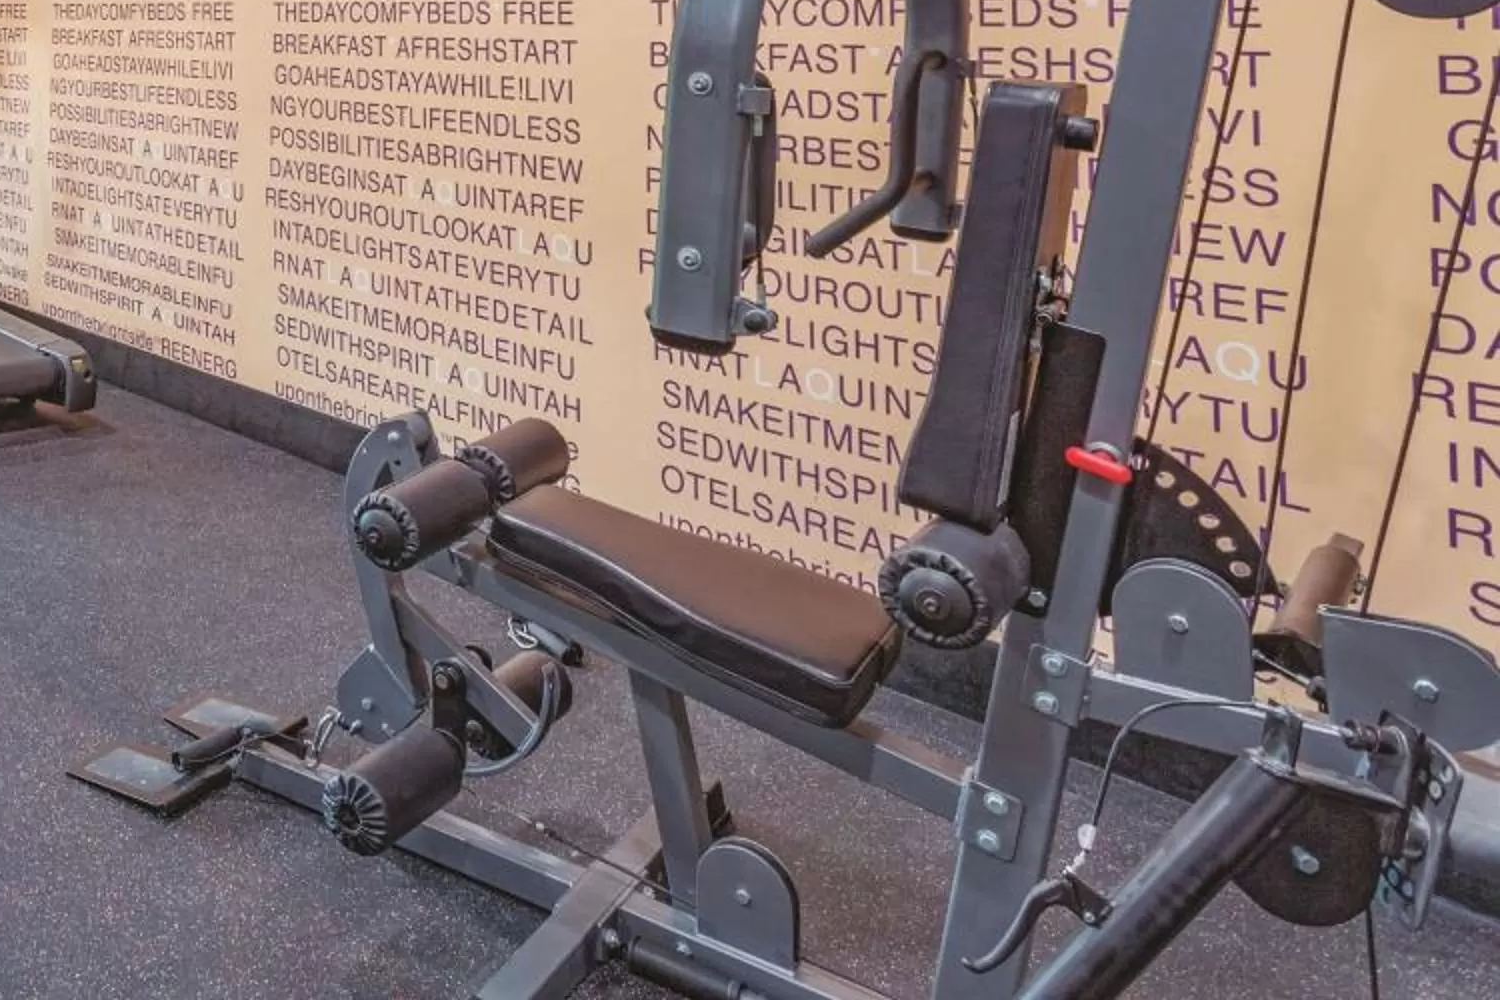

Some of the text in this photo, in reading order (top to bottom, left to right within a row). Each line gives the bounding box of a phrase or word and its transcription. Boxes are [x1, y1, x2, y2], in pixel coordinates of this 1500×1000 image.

[0, 4, 27, 20] FREE
[192, 2, 234, 21] FREE
[273, 1, 575, 25] THEDAYCOMFYBEDS FREE
[52, 28, 123, 47] BREAKFAST
[273, 34, 578, 65] BREAKFAST AFRESHSTART
[274, 63, 574, 104] GOAHEADSTAYAWHILE!LIVI
[270, 94, 581, 145] NGYOURBESTLIFEENDLESS
[269, 126, 583, 185] POSSIBILITIESABRIGHTNEW
[272, 219, 581, 301] INTADELIGHTSATEVERYTU
[277, 283, 576, 381] SMAKEITMEMORABLEINFU
